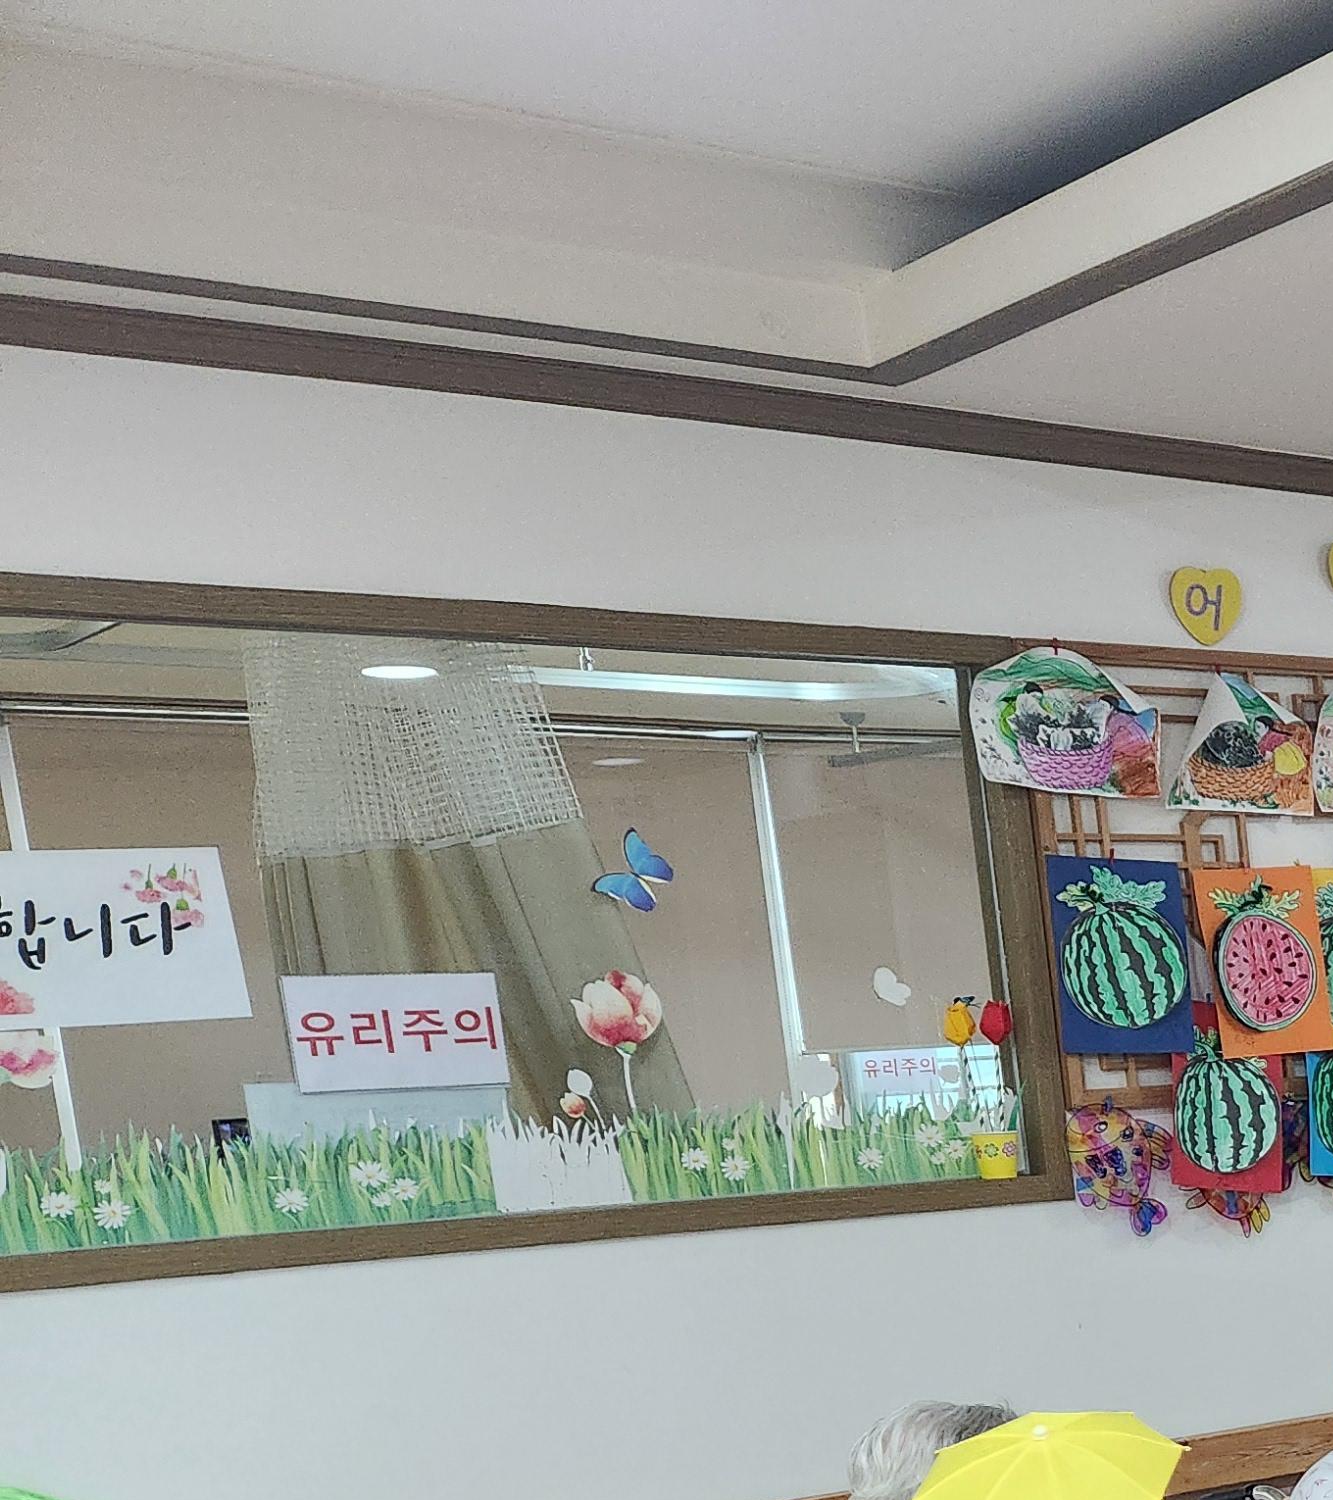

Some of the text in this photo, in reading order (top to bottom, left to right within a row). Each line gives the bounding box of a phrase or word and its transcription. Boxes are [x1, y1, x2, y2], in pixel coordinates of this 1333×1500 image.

[0, 898, 192, 970] 합니다
[296, 1006, 498, 1057] 유리주의
[863, 1057, 937, 1079] 유리주의
